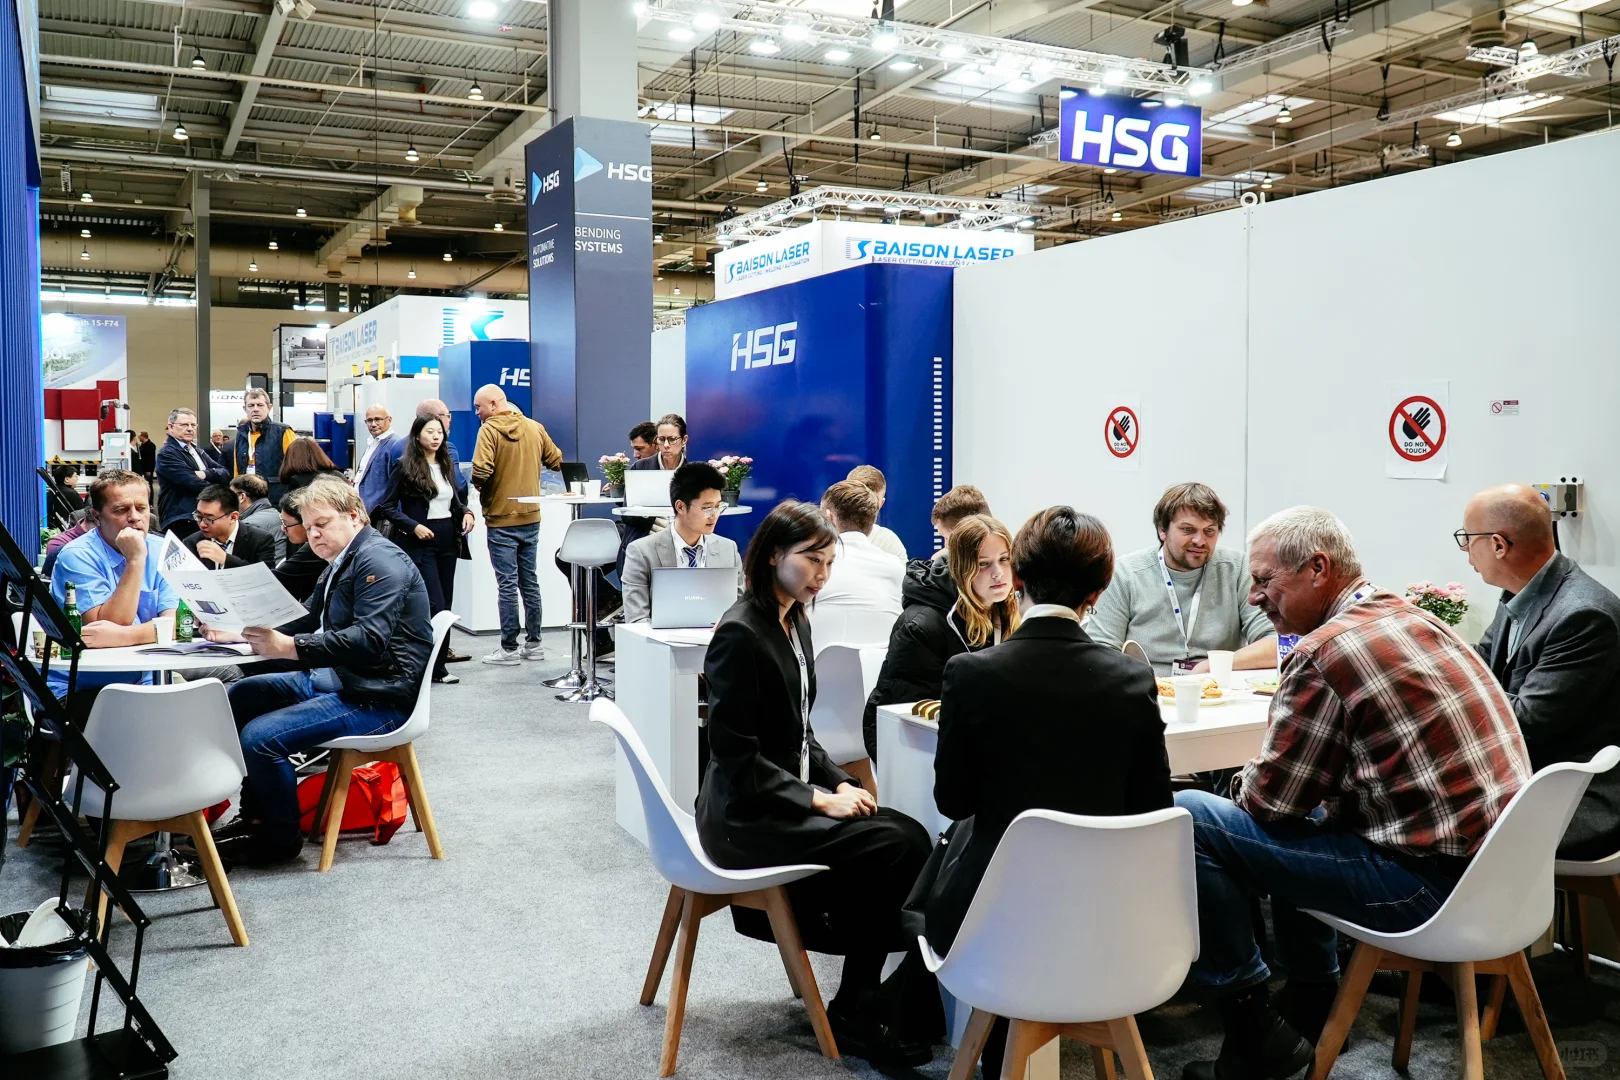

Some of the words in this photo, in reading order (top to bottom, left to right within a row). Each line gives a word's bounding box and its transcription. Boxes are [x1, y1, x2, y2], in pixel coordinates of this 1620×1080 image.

[1071, 110, 1190, 173] HSG
[543, 170, 559, 193] HSG
[608, 162, 652, 182] HSG
[575, 226, 620, 239] BENDING
[575, 241, 623, 254] SYSTEMS
[874, 241, 949, 258] BAISON
[533, 253, 554, 268] SOLUTIONS
[737, 252, 774, 274] BAISON
[775, 241, 810, 262] LASER
[357, 320, 377, 347] LASER
[730, 321, 798, 372] HSG
[500, 367, 530, 386] HS
[798, 653, 806, 667] HSG
